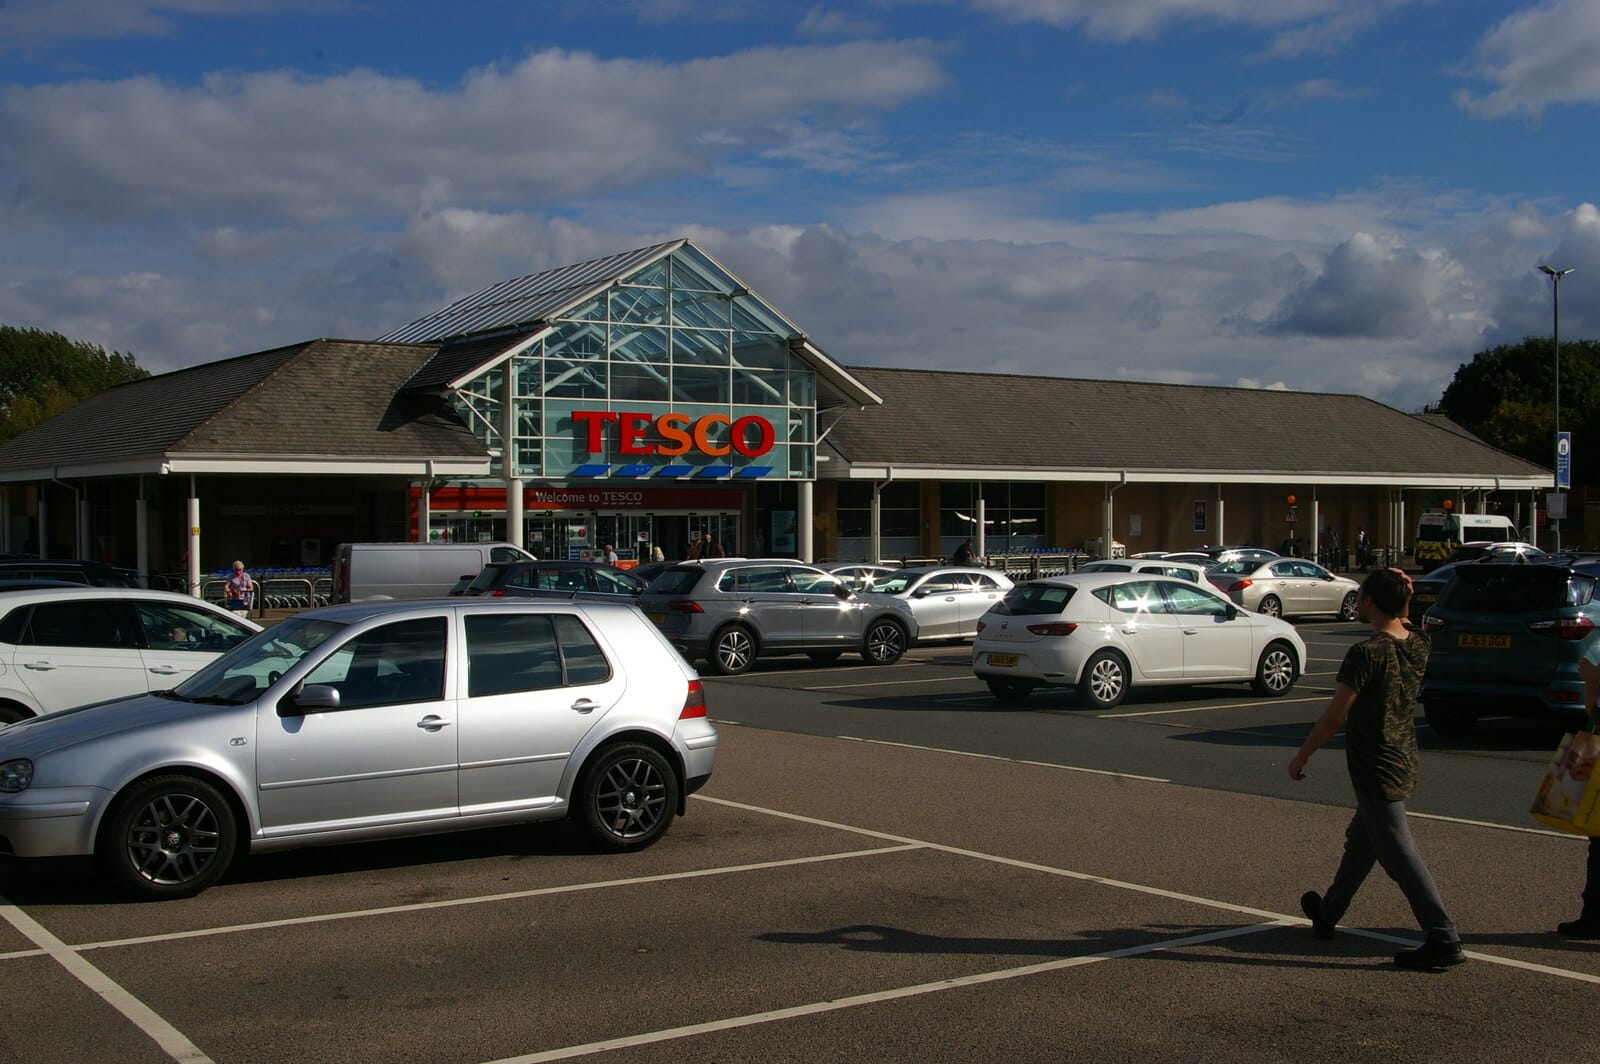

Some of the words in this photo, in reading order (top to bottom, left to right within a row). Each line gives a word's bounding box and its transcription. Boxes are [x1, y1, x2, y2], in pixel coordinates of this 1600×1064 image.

[571, 411, 776, 457] TESCO
[535, 491, 585, 503] Welcome
[588, 492, 600, 503] to
[601, 491, 643, 502] TESCO
